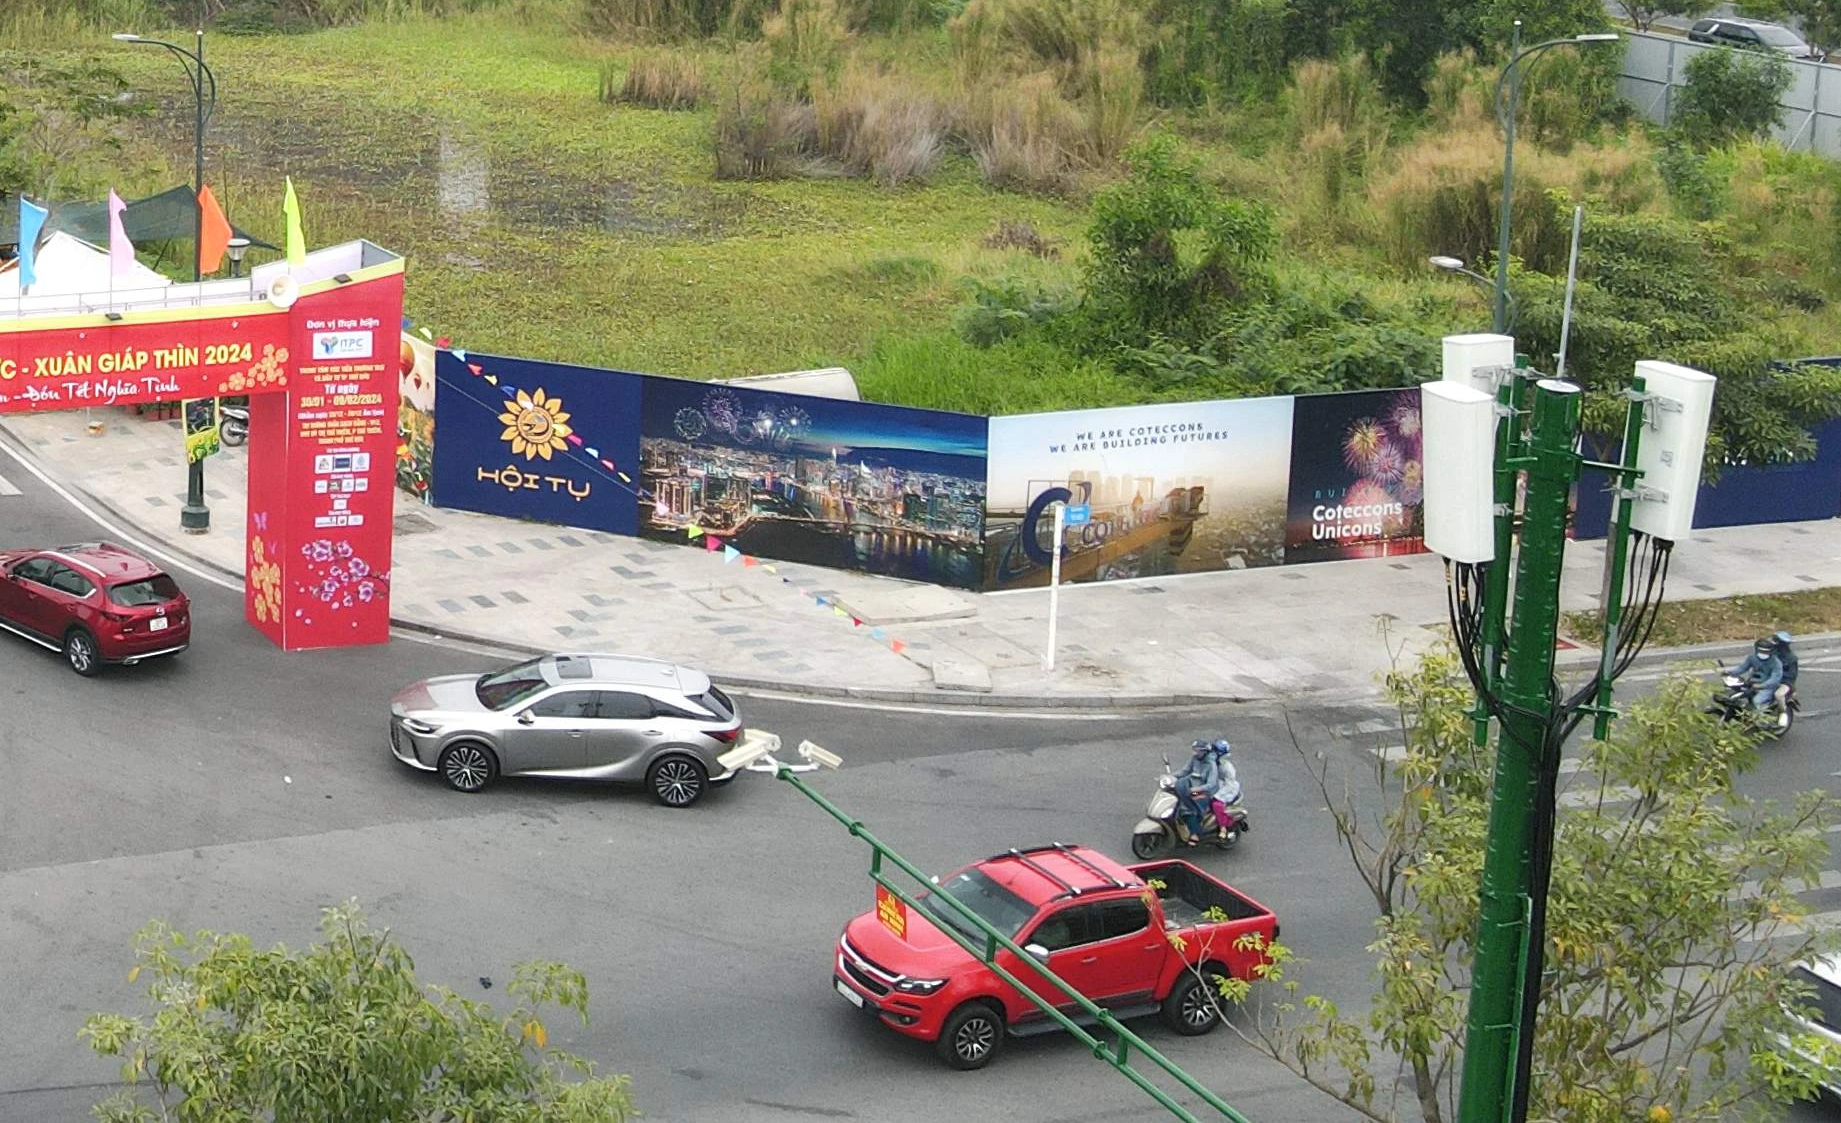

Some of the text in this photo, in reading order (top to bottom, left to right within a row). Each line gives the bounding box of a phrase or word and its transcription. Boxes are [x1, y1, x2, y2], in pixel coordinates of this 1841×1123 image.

[340, 338, 364, 348] ITPC
[33, 351, 92, 377] XUÂN
[97, 346, 148, 372] GIÁP
[153, 342, 199, 368] THÌN
[205, 343, 253, 366] 2024
[1049, 444, 1067, 453] WE
[1073, 442, 1095, 452] ARE
[1173, 431, 1228, 443] FUTURES
[1077, 423, 1203, 441] WE ARE COTECCONS
[477, 464, 591, 502] HỘI TỤ
[1312, 502, 1403, 522] Coteccons
[1312, 521, 1382, 540] Unicons
